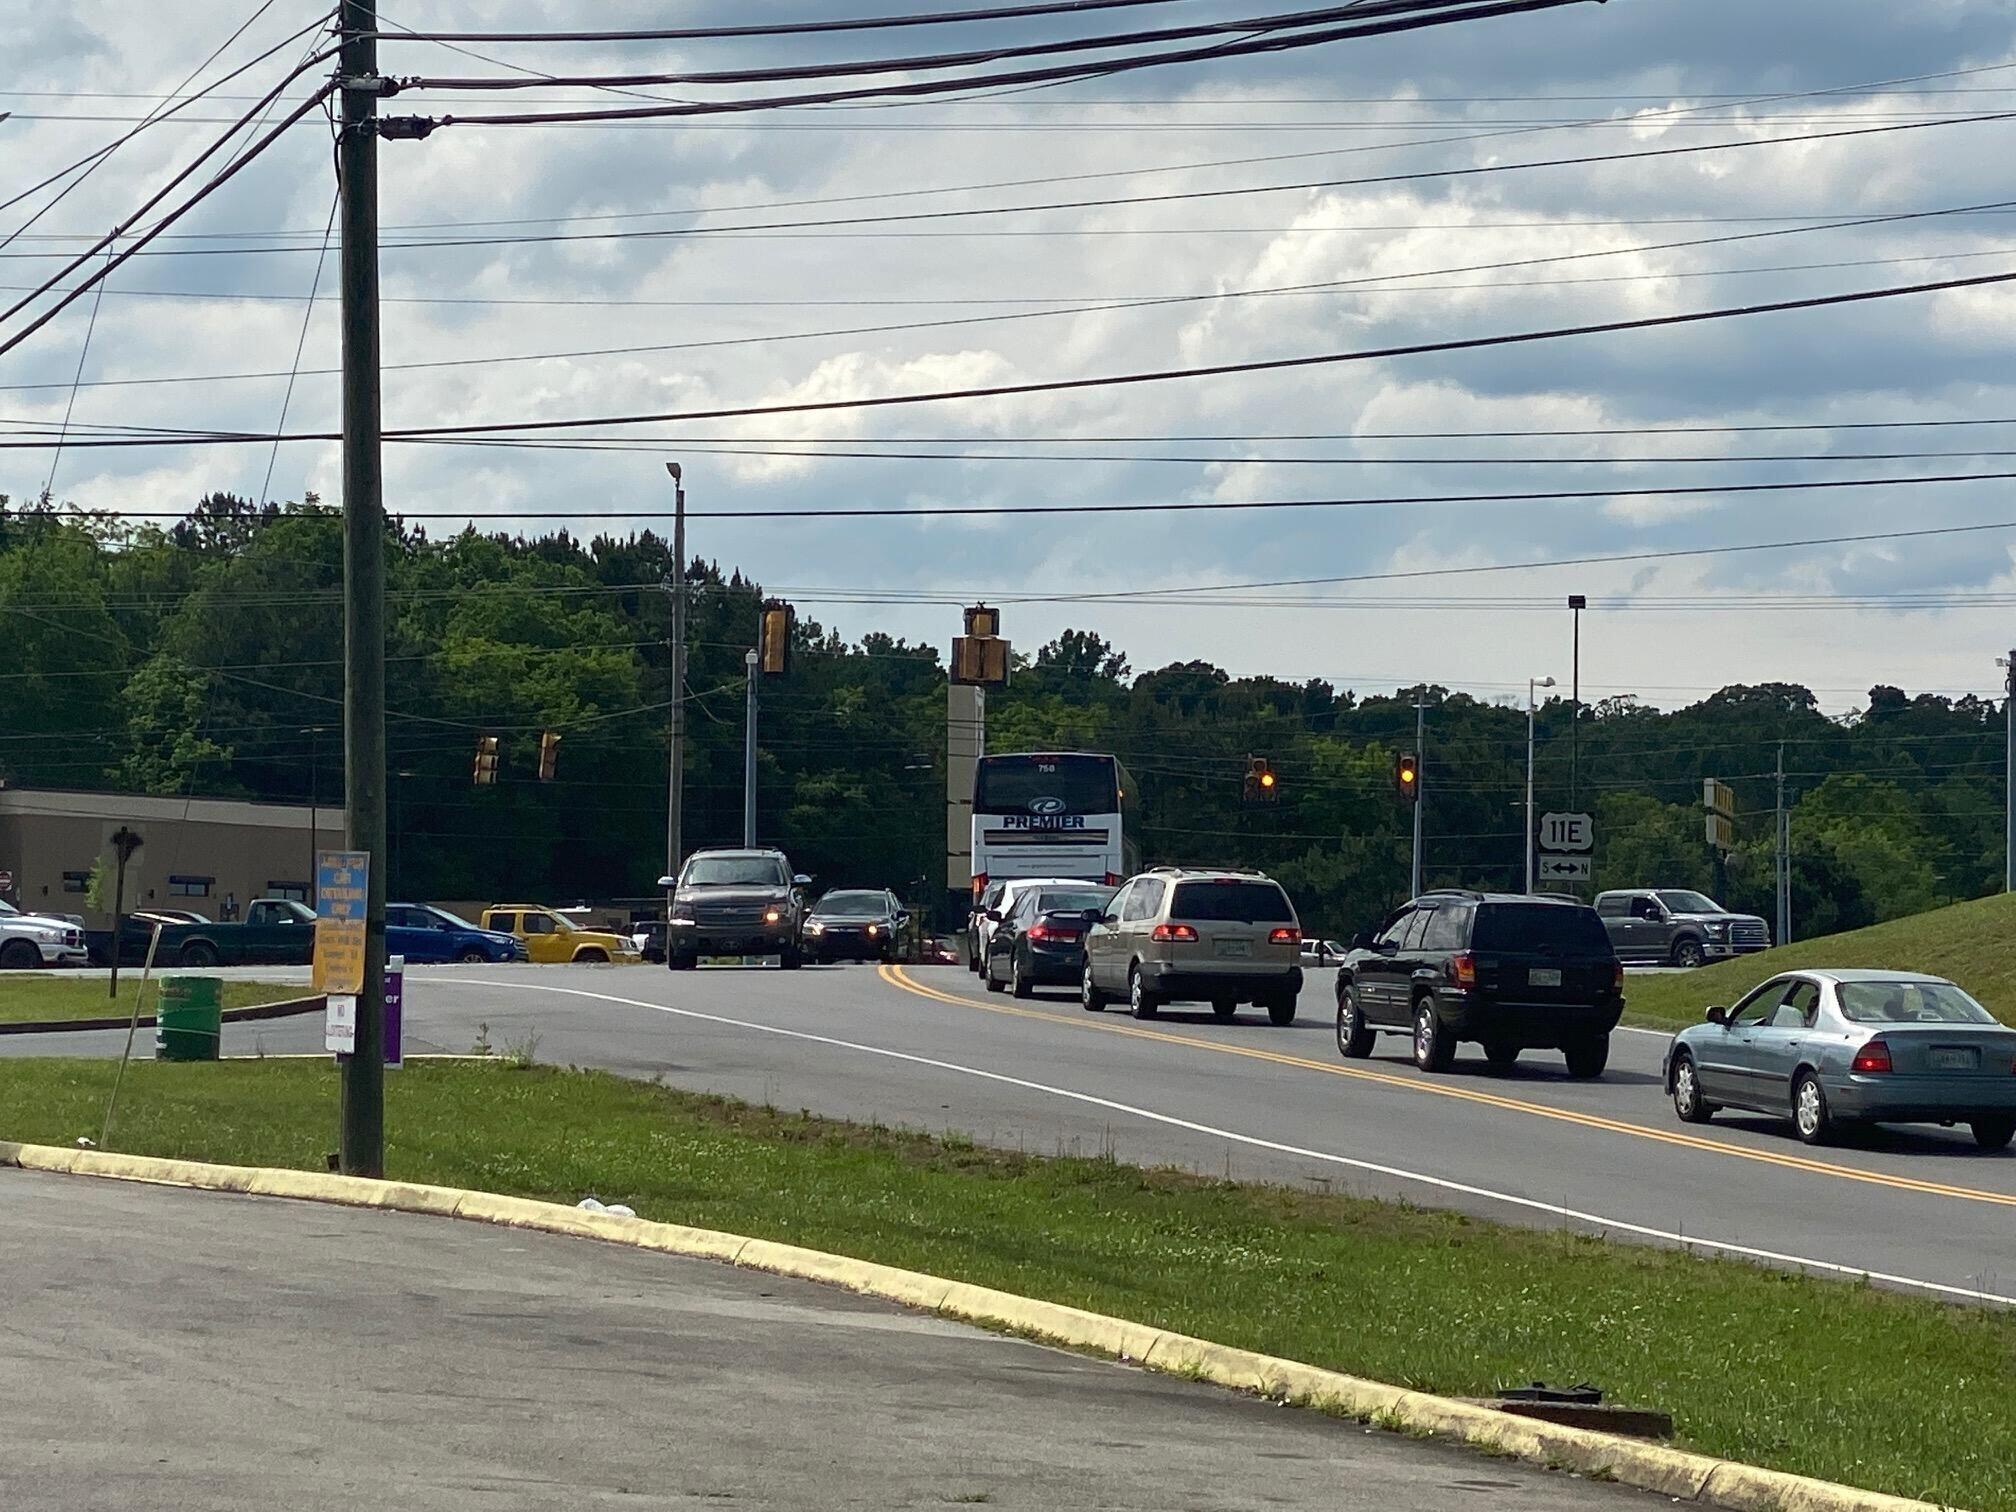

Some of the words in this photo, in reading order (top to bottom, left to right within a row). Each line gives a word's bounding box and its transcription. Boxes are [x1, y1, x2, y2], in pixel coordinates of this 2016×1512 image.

[1003, 815, 1085, 828] PREMIER
[1550, 820, 1583, 843] 11E
[1542, 862, 1549, 874] S
[1581, 863, 1588, 875] N
